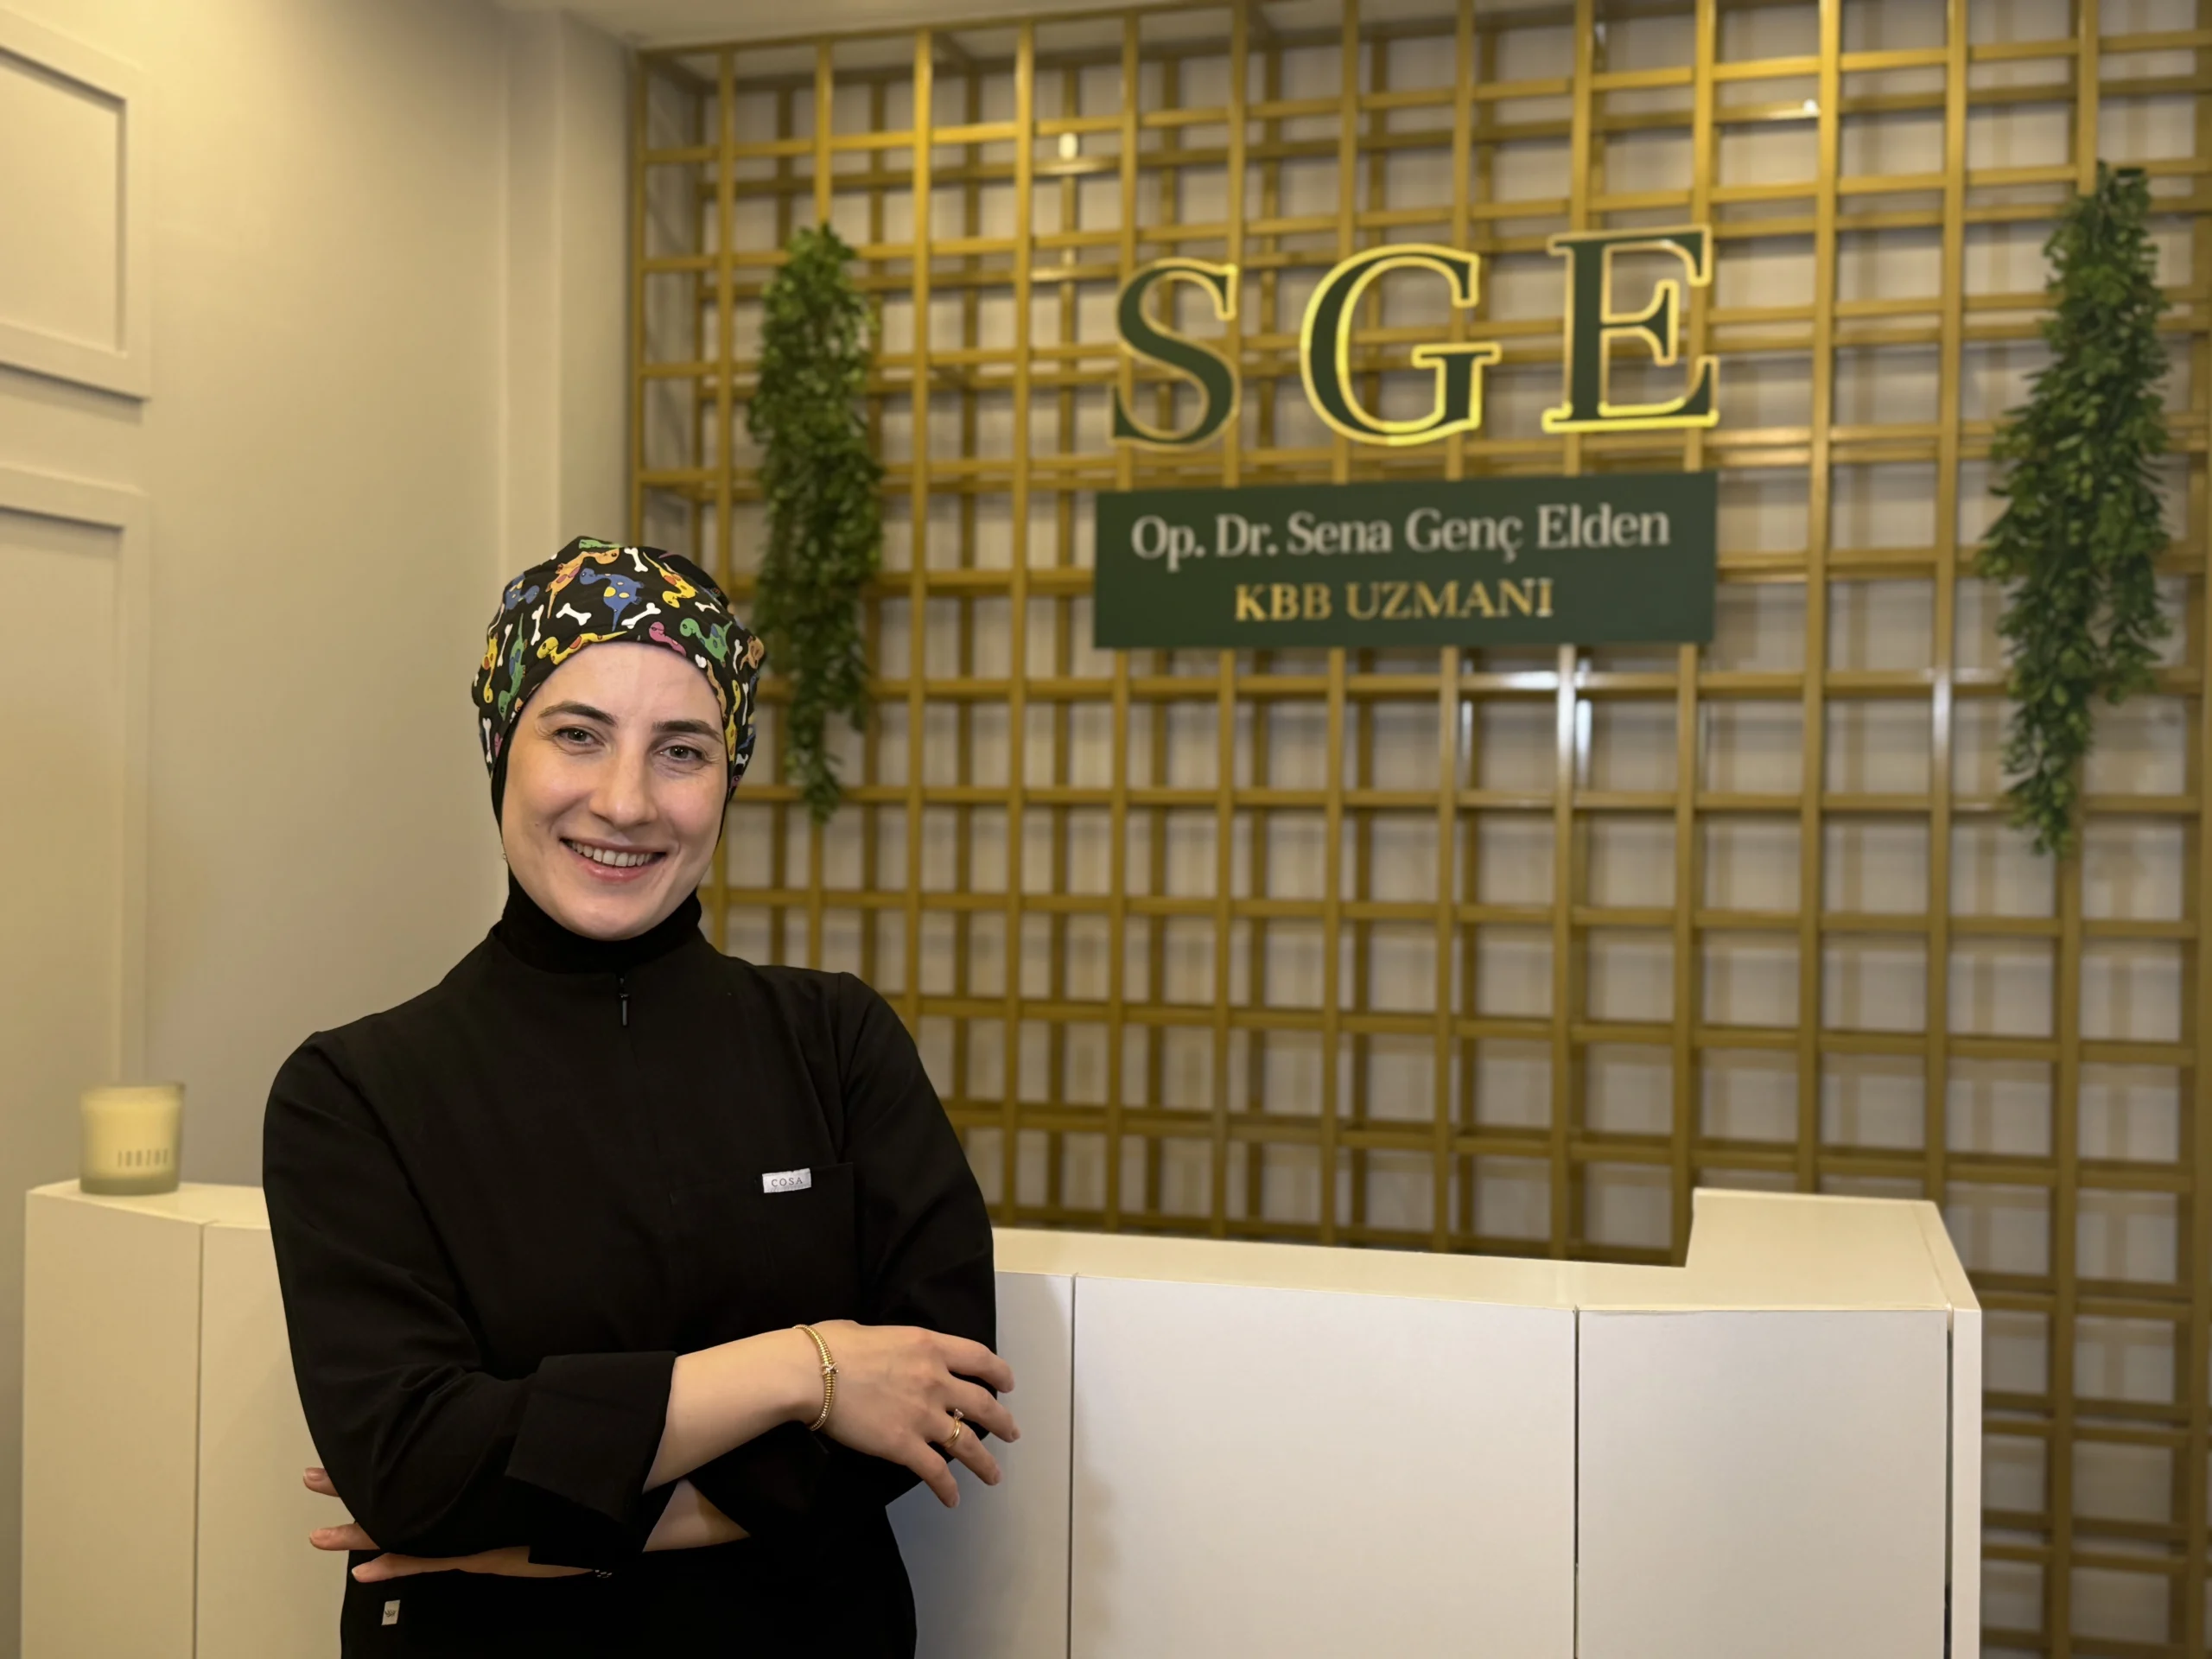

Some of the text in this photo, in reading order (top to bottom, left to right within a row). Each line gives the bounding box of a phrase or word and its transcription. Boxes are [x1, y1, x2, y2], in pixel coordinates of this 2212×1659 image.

[1130, 501, 1671, 573] Op. Dr. Sena Genç Elden
[1235, 576, 1554, 621] KBB UZMANI
[771, 1176, 804, 1187] COSA
